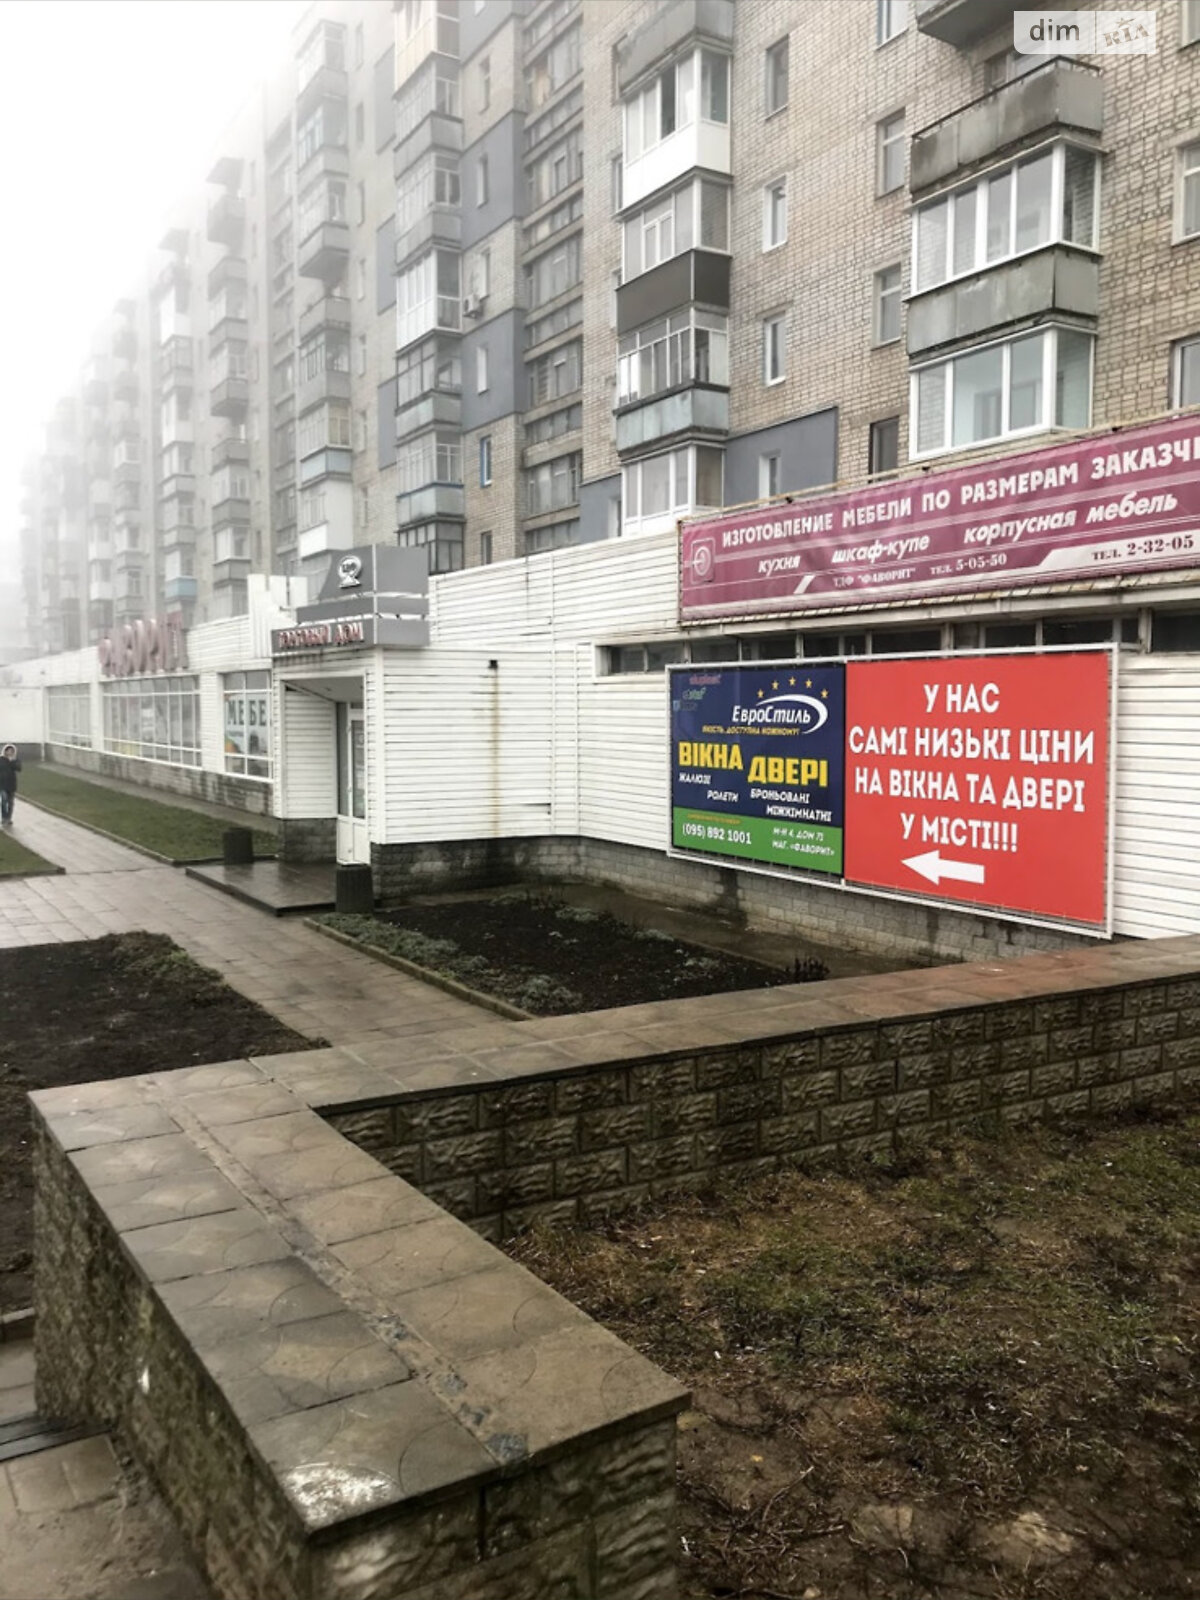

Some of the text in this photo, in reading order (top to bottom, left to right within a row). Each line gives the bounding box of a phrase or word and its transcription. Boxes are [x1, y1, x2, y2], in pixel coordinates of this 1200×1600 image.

[723, 513, 833, 548] ИЗГОТОВЛЕНИЕ
[842, 497, 912, 532] МЕБЕЛИ
[922, 489, 950, 513] ПО
[961, 462, 1079, 505] РАЗМЕРАМ
[758, 490, 1178, 577] кухня шкаф-купе корпусная мебель
[1127, 534, 1195, 556] 2-32-05
[956, 553, 1008, 572] 5-05-50
[924, 683, 1000, 713] У НАС
[732, 705, 812, 726] ЕвроСтиль
[678, 741, 743, 770] ВІКНА
[849, 726, 1094, 765] САМІ НИЗЬКІ ЦІНИ
[748, 756, 828, 787] ДВЕРІ
[707, 789, 739, 802] РОЛЕТИ
[750, 788, 811, 804] БРОНЬОВАНІ
[855, 767, 1085, 812] НА ВІКНА ТА ДВЕРІ
[682, 822, 752, 845] (095) 892 1001
[901, 812, 1018, 853] У МІСТІ!!!
